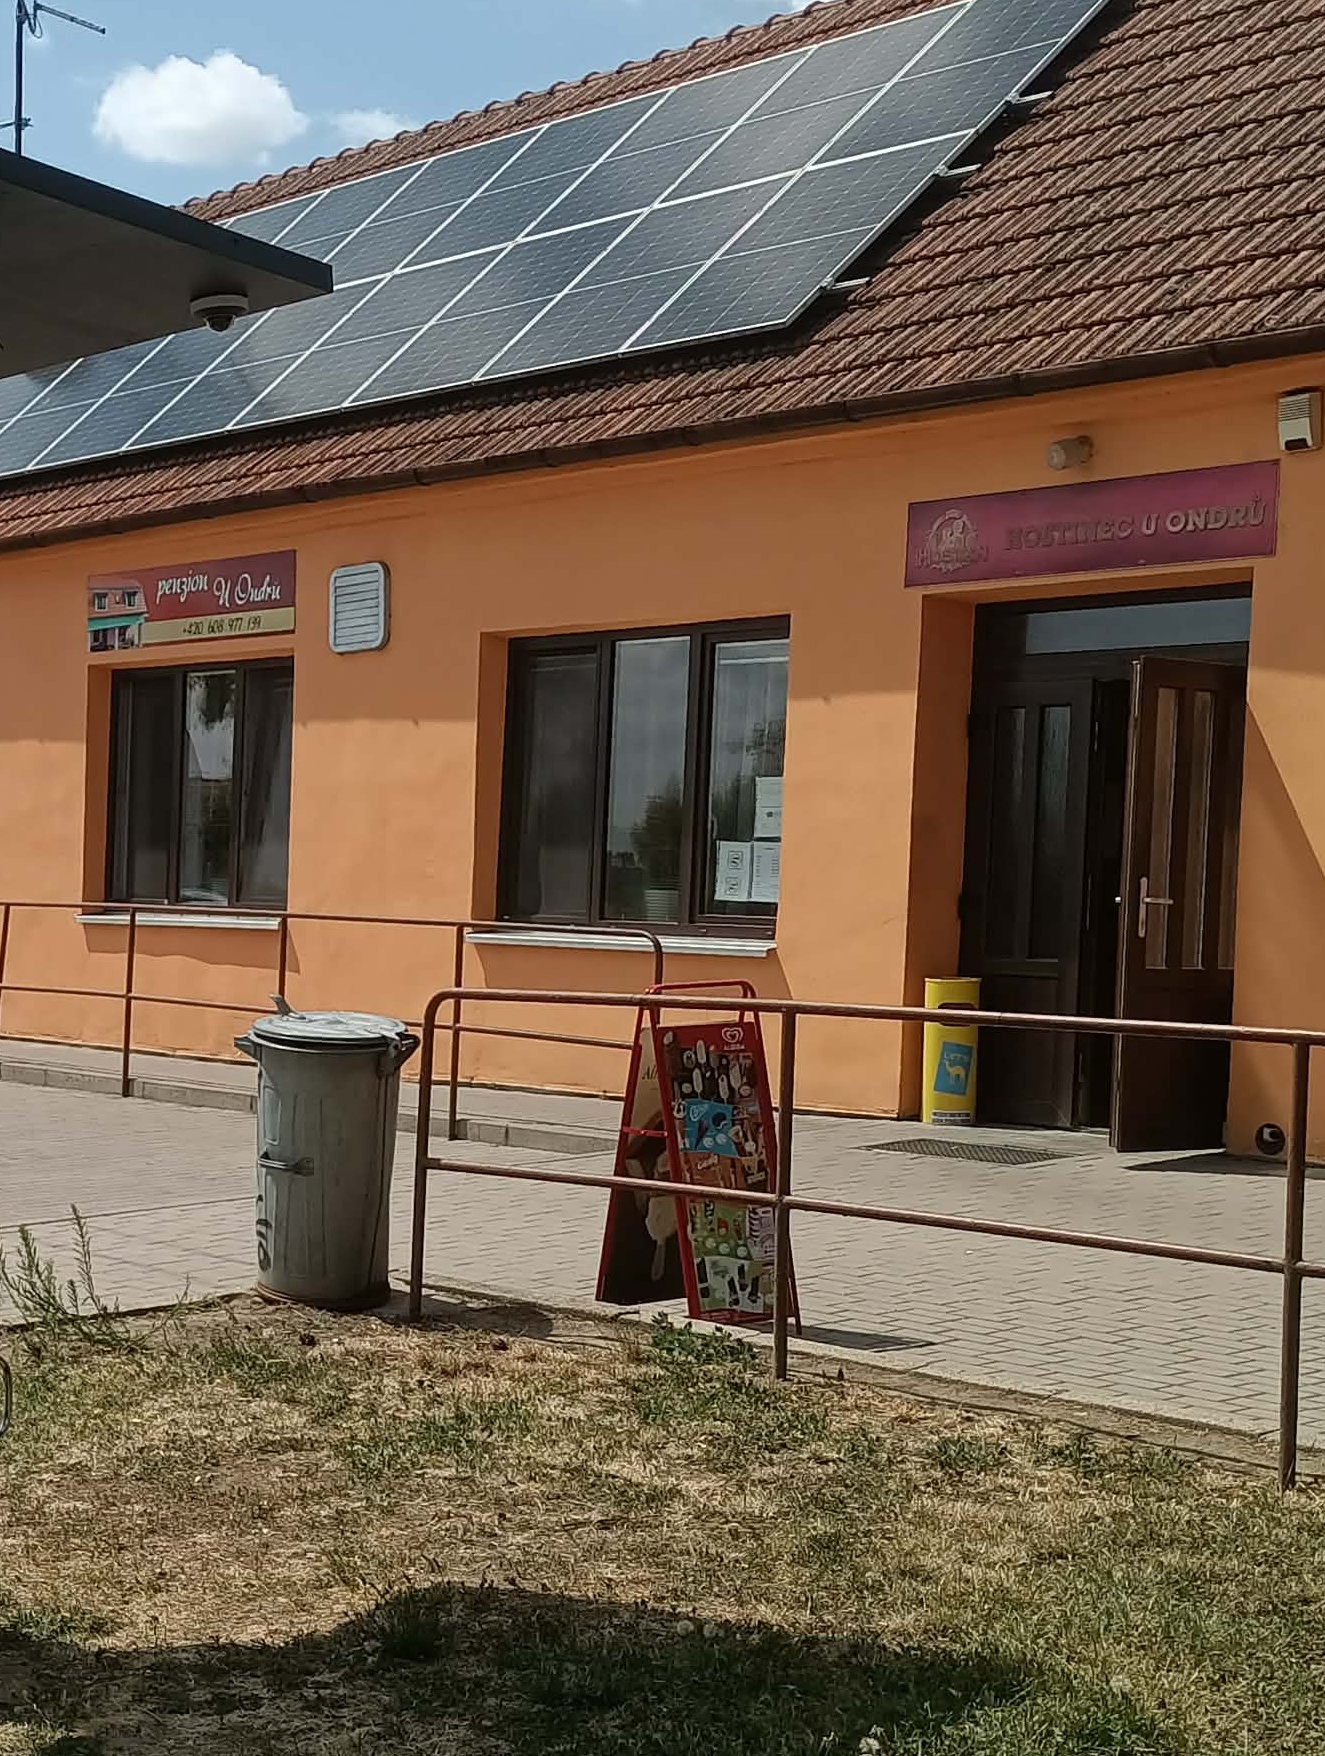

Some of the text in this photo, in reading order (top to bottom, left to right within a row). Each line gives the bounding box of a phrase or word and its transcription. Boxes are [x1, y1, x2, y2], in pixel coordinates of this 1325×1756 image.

[1006, 516, 1134, 551] HOSTINEC
[1141, 512, 1161, 536] U
[156, 569, 209, 605] penzion
